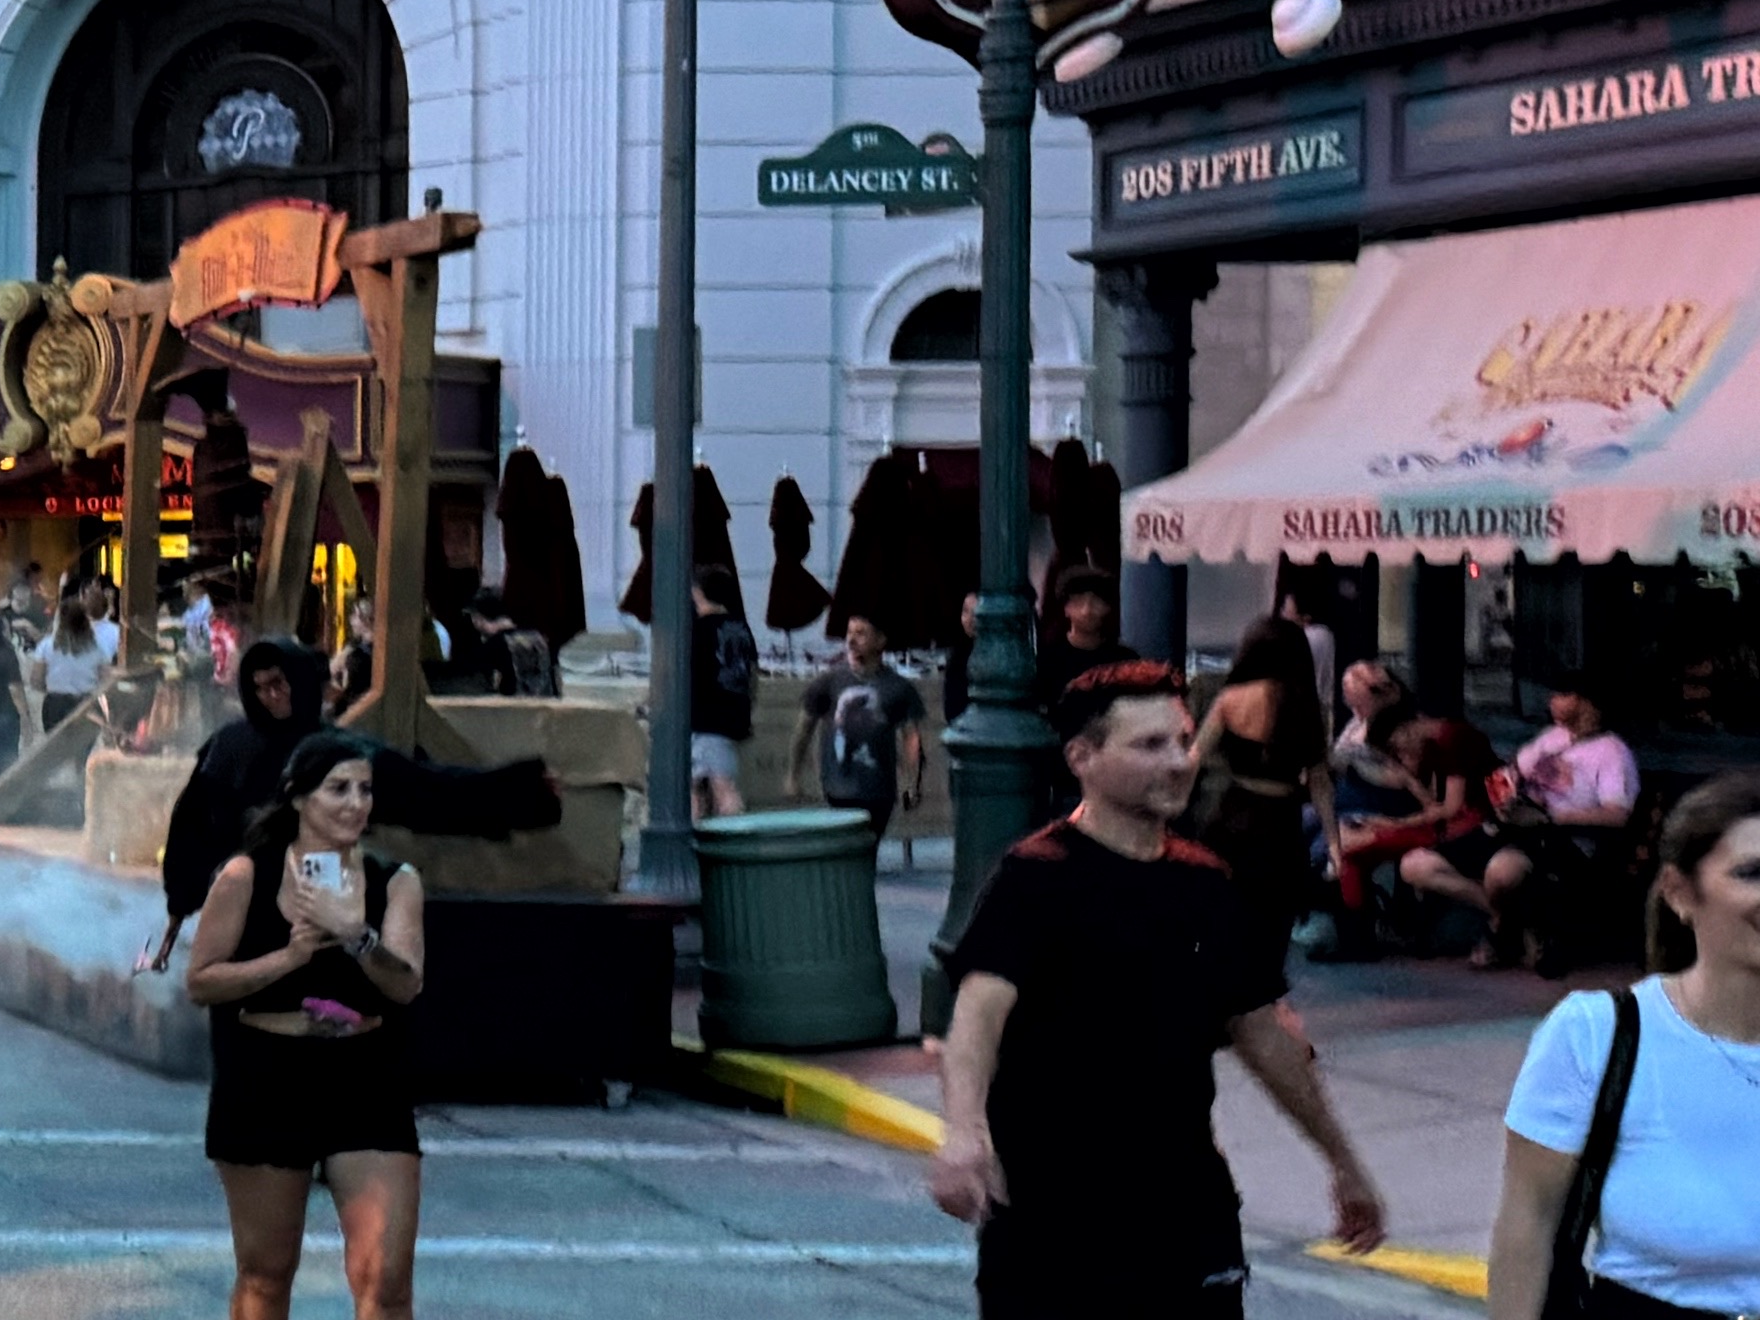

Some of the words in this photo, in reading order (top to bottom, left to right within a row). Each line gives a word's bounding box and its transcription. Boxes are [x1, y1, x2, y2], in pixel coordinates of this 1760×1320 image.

[1509, 62, 1691, 137] SAHARA
[770, 167, 913, 194] DELANCEY
[920, 166, 959, 192] ST.
[1179, 140, 1273, 194] FIFTH
[1283, 508, 1404, 541] SAHARA
[1410, 503, 1566, 538] TRADERS
